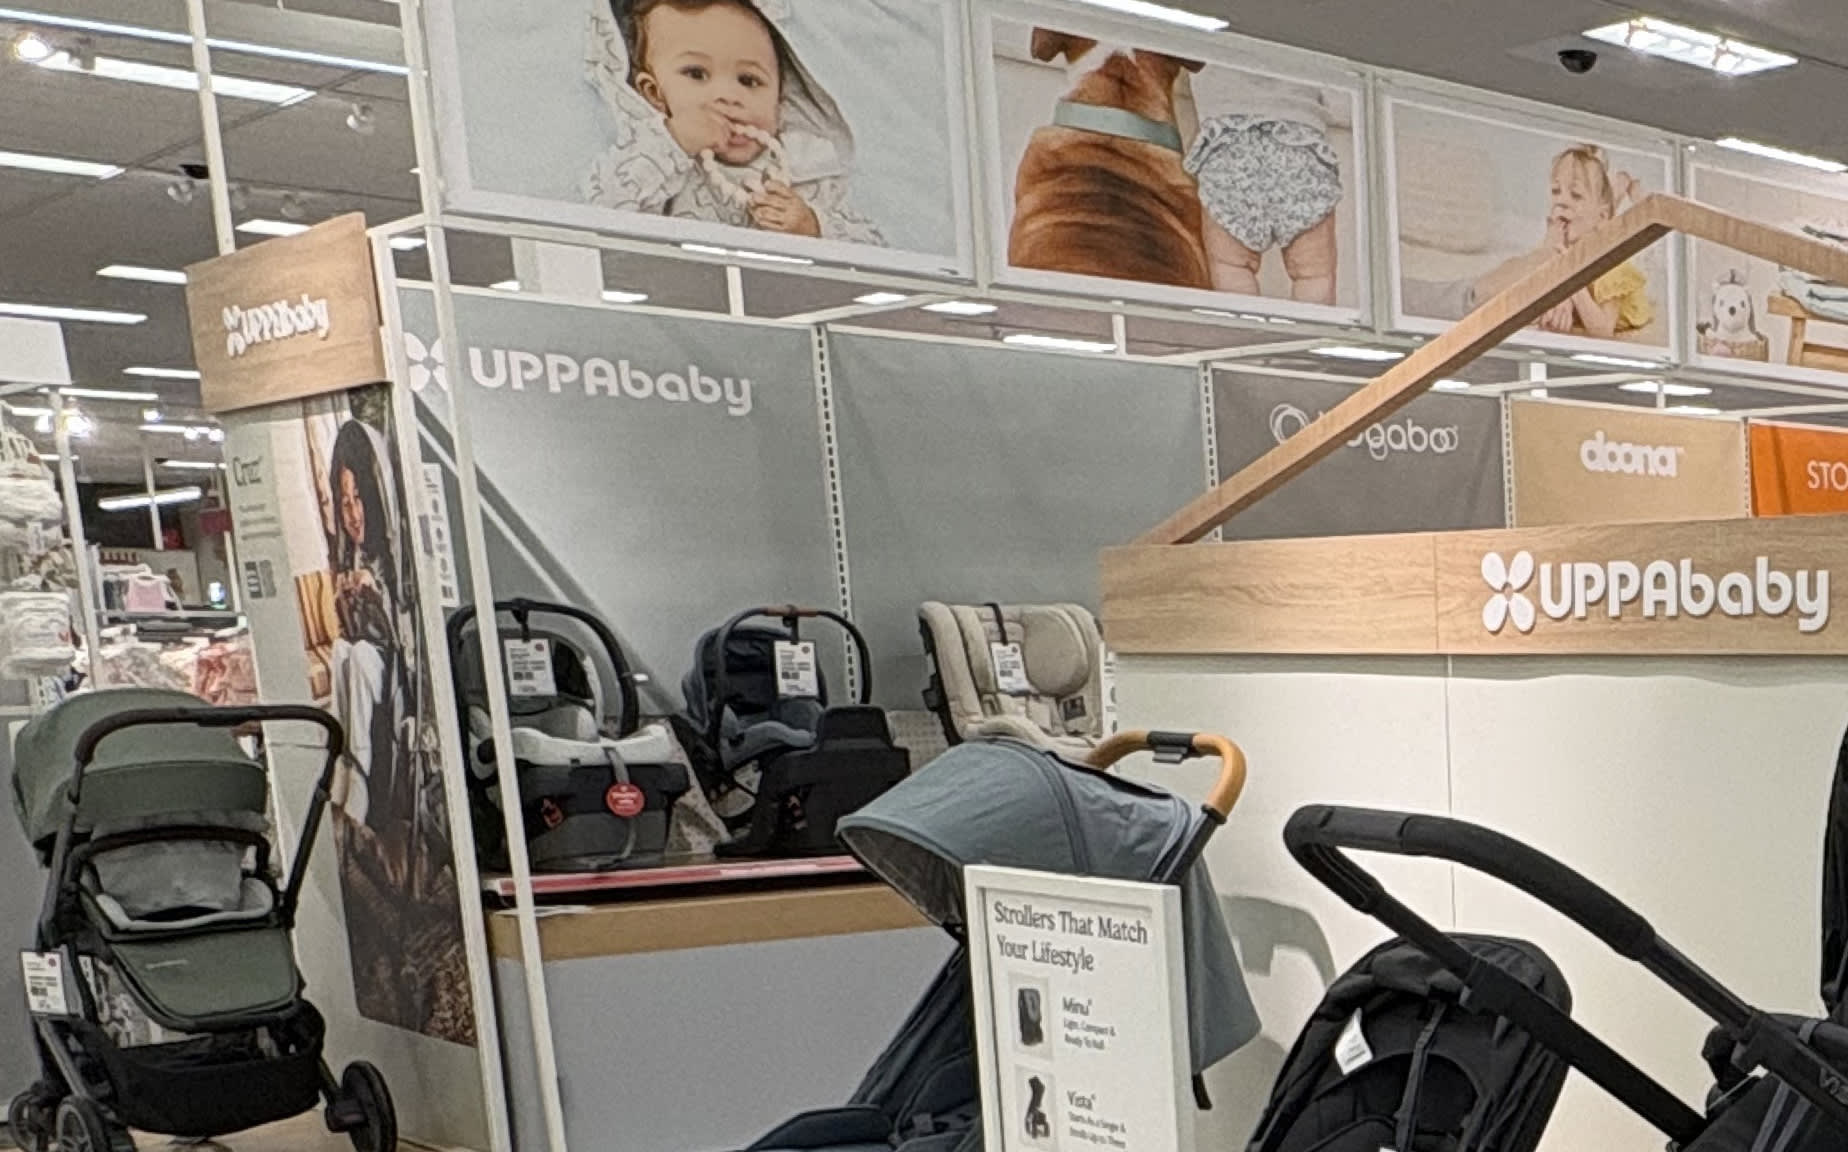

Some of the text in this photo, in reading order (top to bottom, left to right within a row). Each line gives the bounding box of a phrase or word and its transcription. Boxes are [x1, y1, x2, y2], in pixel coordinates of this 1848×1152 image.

[468, 347, 754, 417] UPPAbaby
[1319, 411, 1459, 461] gaboo
[1580, 430, 1677, 477] doona
[1539, 556, 1830, 633] UPPAbaby
[994, 901, 1148, 944] Strollers That Match
[997, 934, 1094, 974] Your Lifestyle
